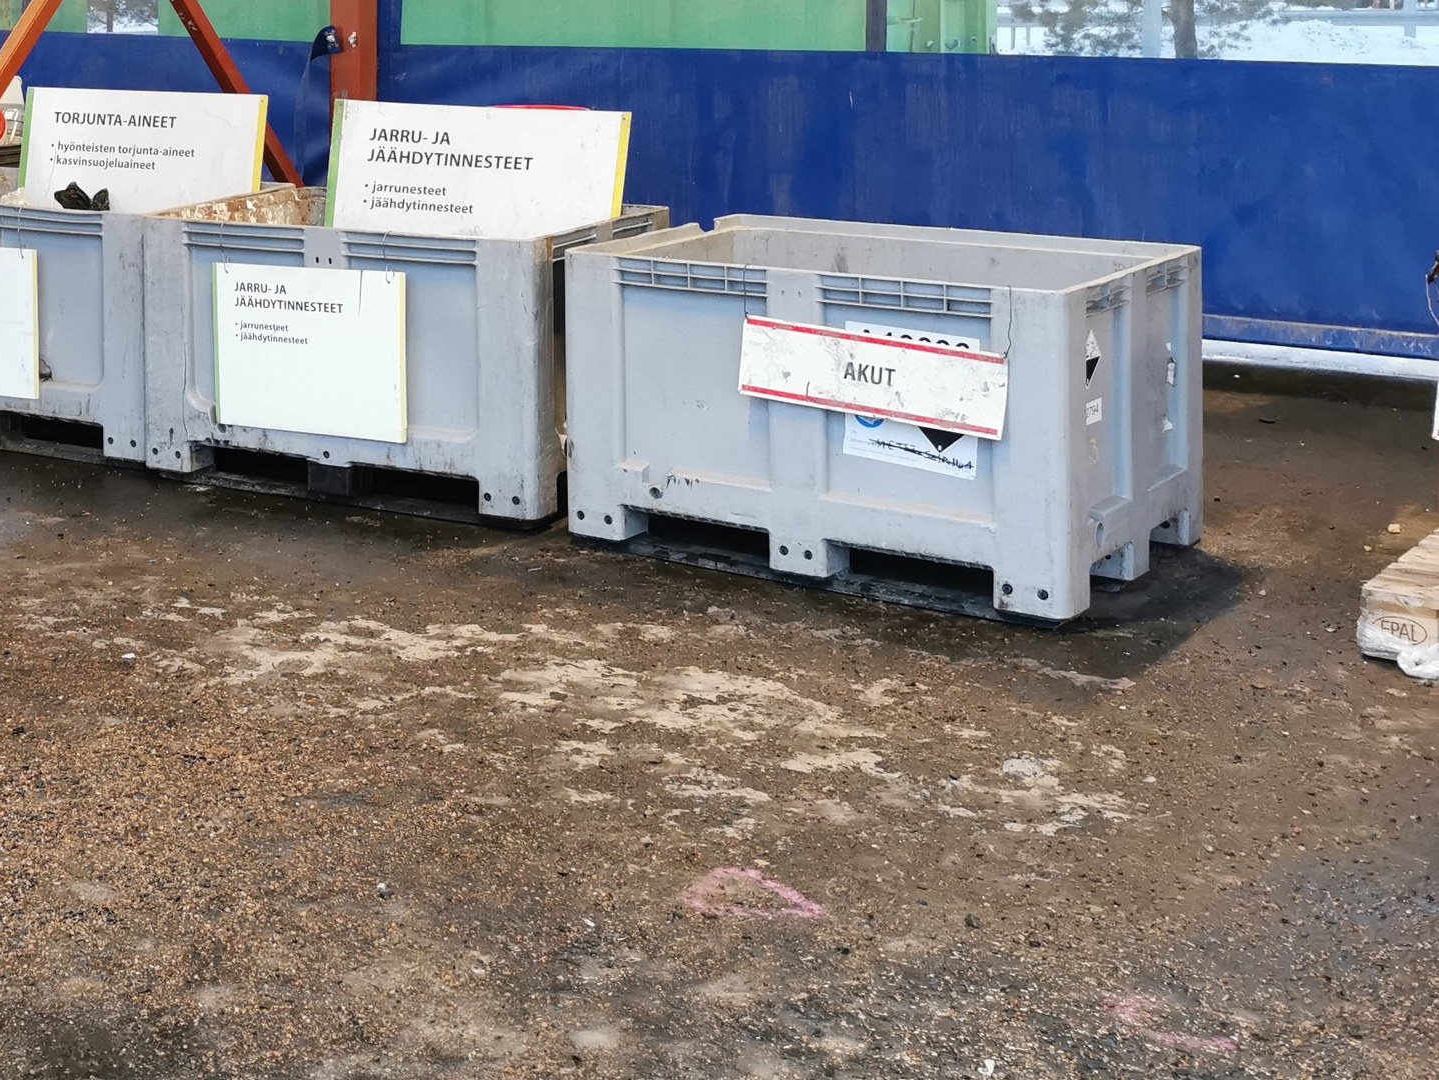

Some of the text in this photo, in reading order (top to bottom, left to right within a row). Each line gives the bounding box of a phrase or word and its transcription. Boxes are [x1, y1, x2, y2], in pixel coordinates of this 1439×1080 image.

[54, 111, 177, 128] TORJUNTA-AINEET
[369, 128, 451, 145] JARRU- JA
[57, 141, 195, 158] hyönteisten torjunta-aineet
[56, 155, 156, 170] kasvinsuojeluaineet
[367, 146, 533, 171] JÄÄHDYTINNESTEET
[371, 181, 447, 196] jarrunesteet
[370, 196, 473, 214] jäähdytinnesteet
[234, 281, 287, 295] JARRU- JA
[235, 295, 343, 314] JÄÄHDYTINNESTEET
[240, 320, 289, 331] jarrunesteet
[240, 332, 308, 345] jäähdytinnesteet
[843, 361, 896, 387] AKUT
